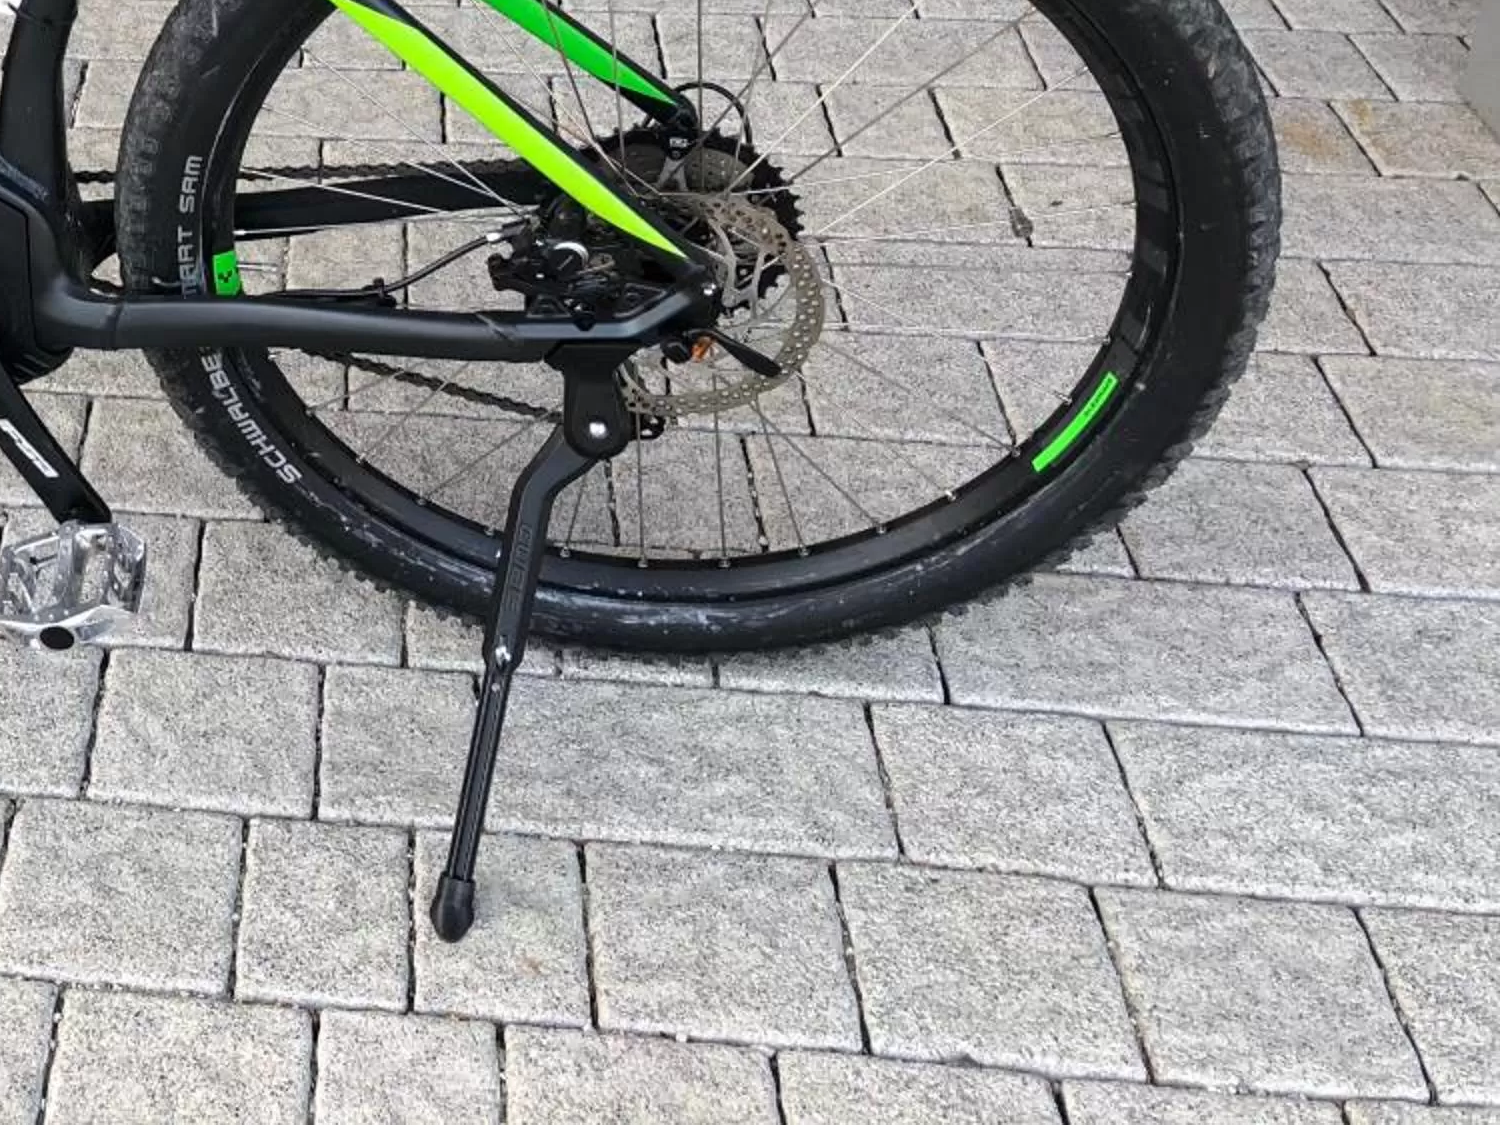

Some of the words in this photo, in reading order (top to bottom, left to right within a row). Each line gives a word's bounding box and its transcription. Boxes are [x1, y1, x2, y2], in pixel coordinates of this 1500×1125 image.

[179, 154, 204, 214] SAM
[177, 225, 198, 299] MART
[201, 350, 303, 485] SCHWALBE
